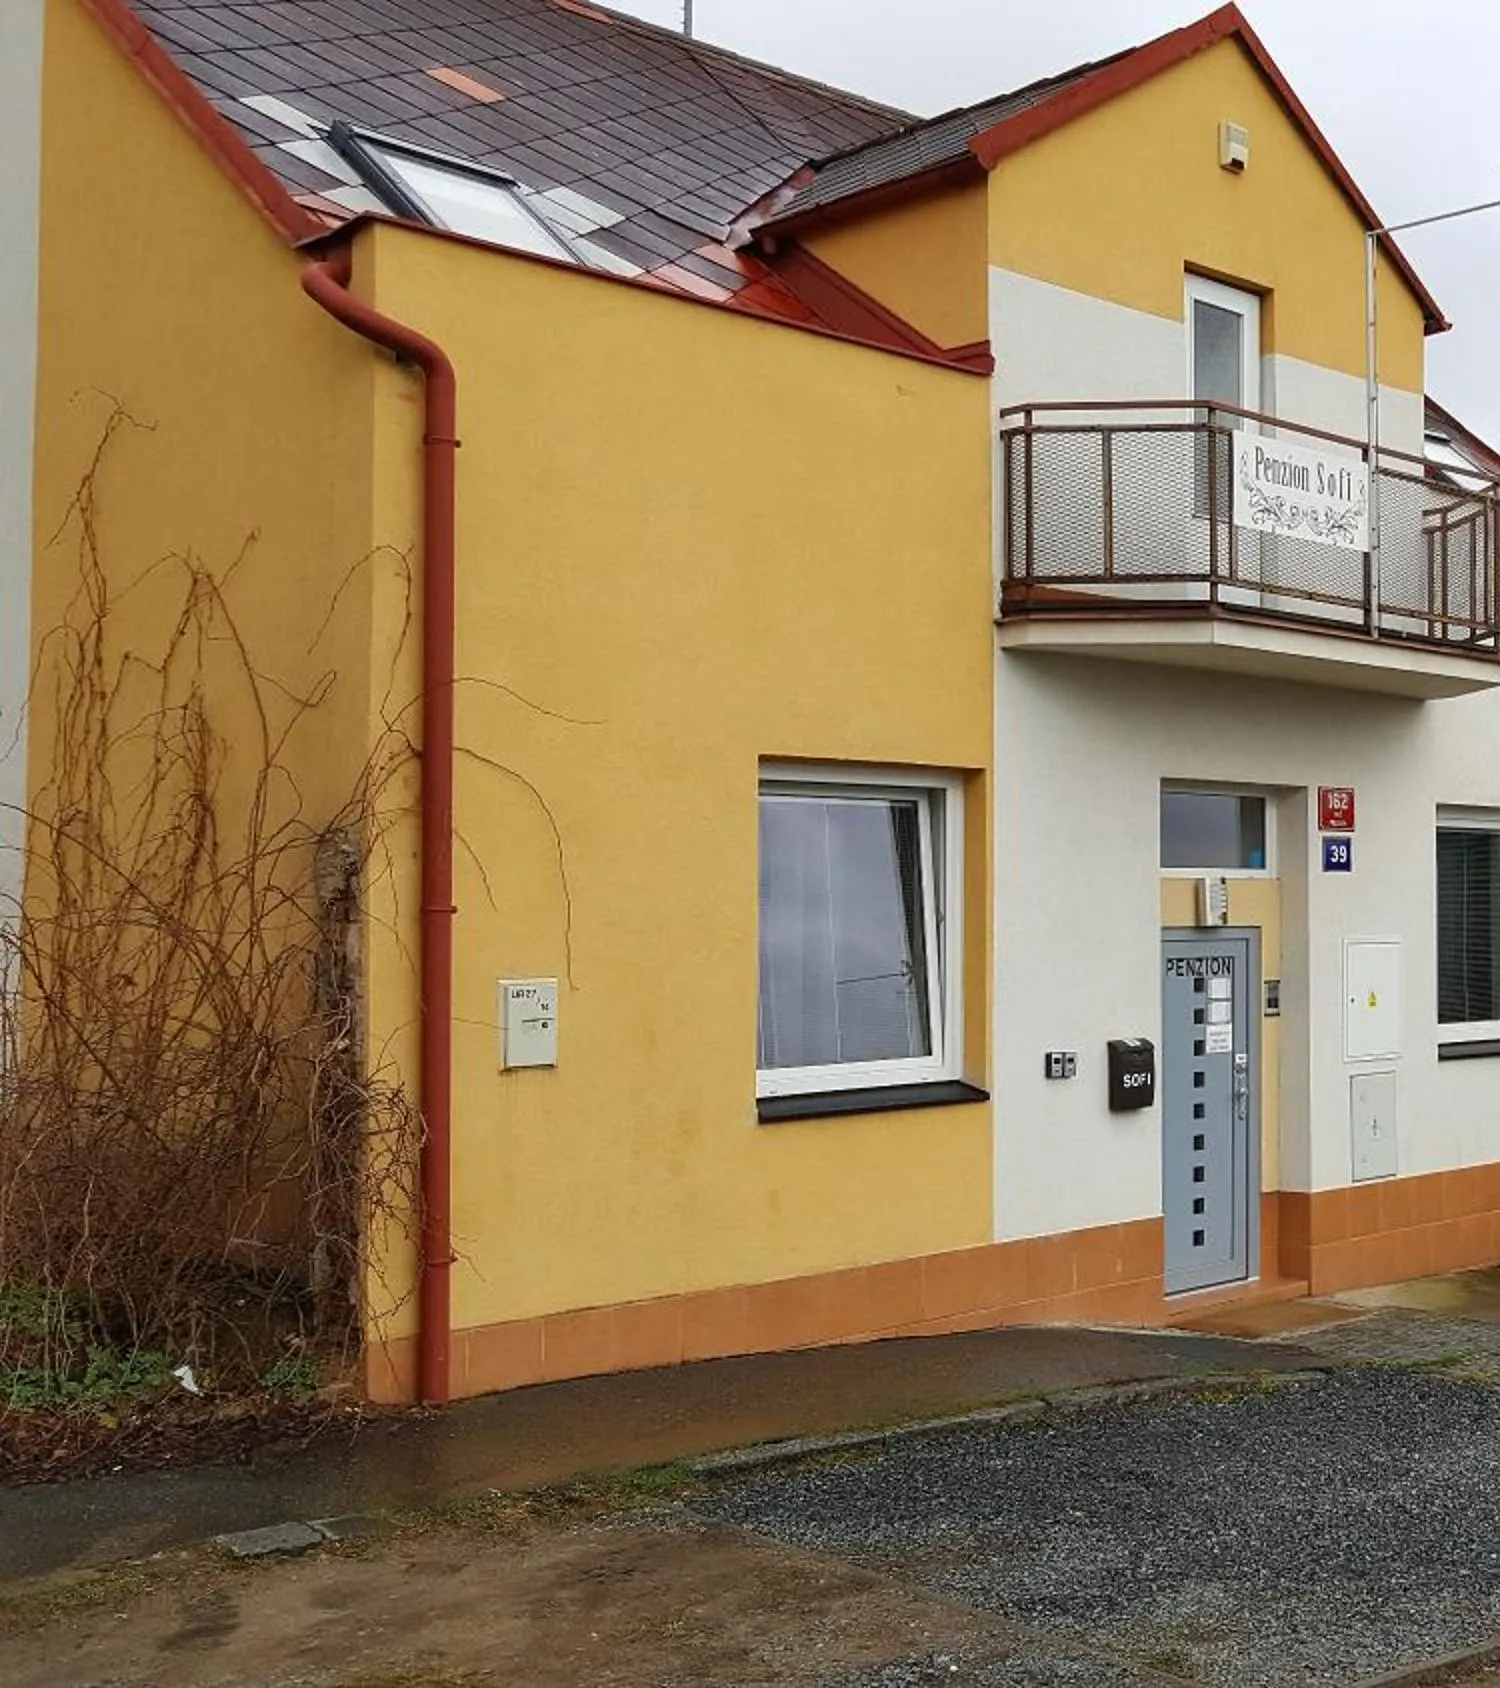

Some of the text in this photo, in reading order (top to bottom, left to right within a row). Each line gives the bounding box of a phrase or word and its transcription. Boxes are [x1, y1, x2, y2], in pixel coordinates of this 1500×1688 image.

[1255, 446, 1352, 501] Penzion Sofi
[1330, 845, 1347, 863] 39
[1166, 957, 1231, 977] PENZION
[1123, 1073, 1151, 1088] SOFI
